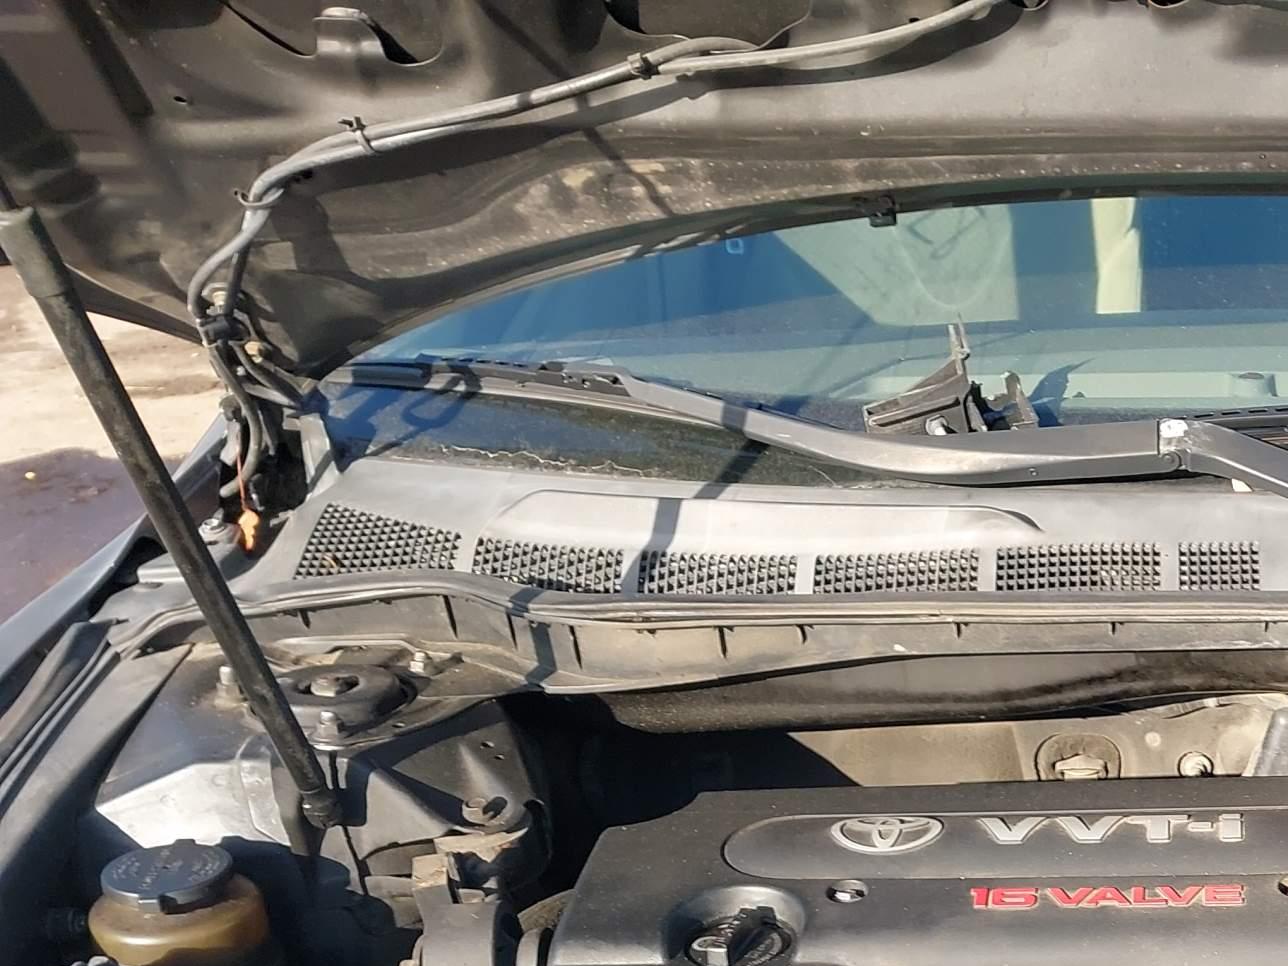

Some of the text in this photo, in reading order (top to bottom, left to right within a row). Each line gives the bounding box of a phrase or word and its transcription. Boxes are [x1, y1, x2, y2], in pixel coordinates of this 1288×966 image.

[978, 813, 1245, 844] VVT-i
[970, 885, 1247, 909] 16 VALVE
